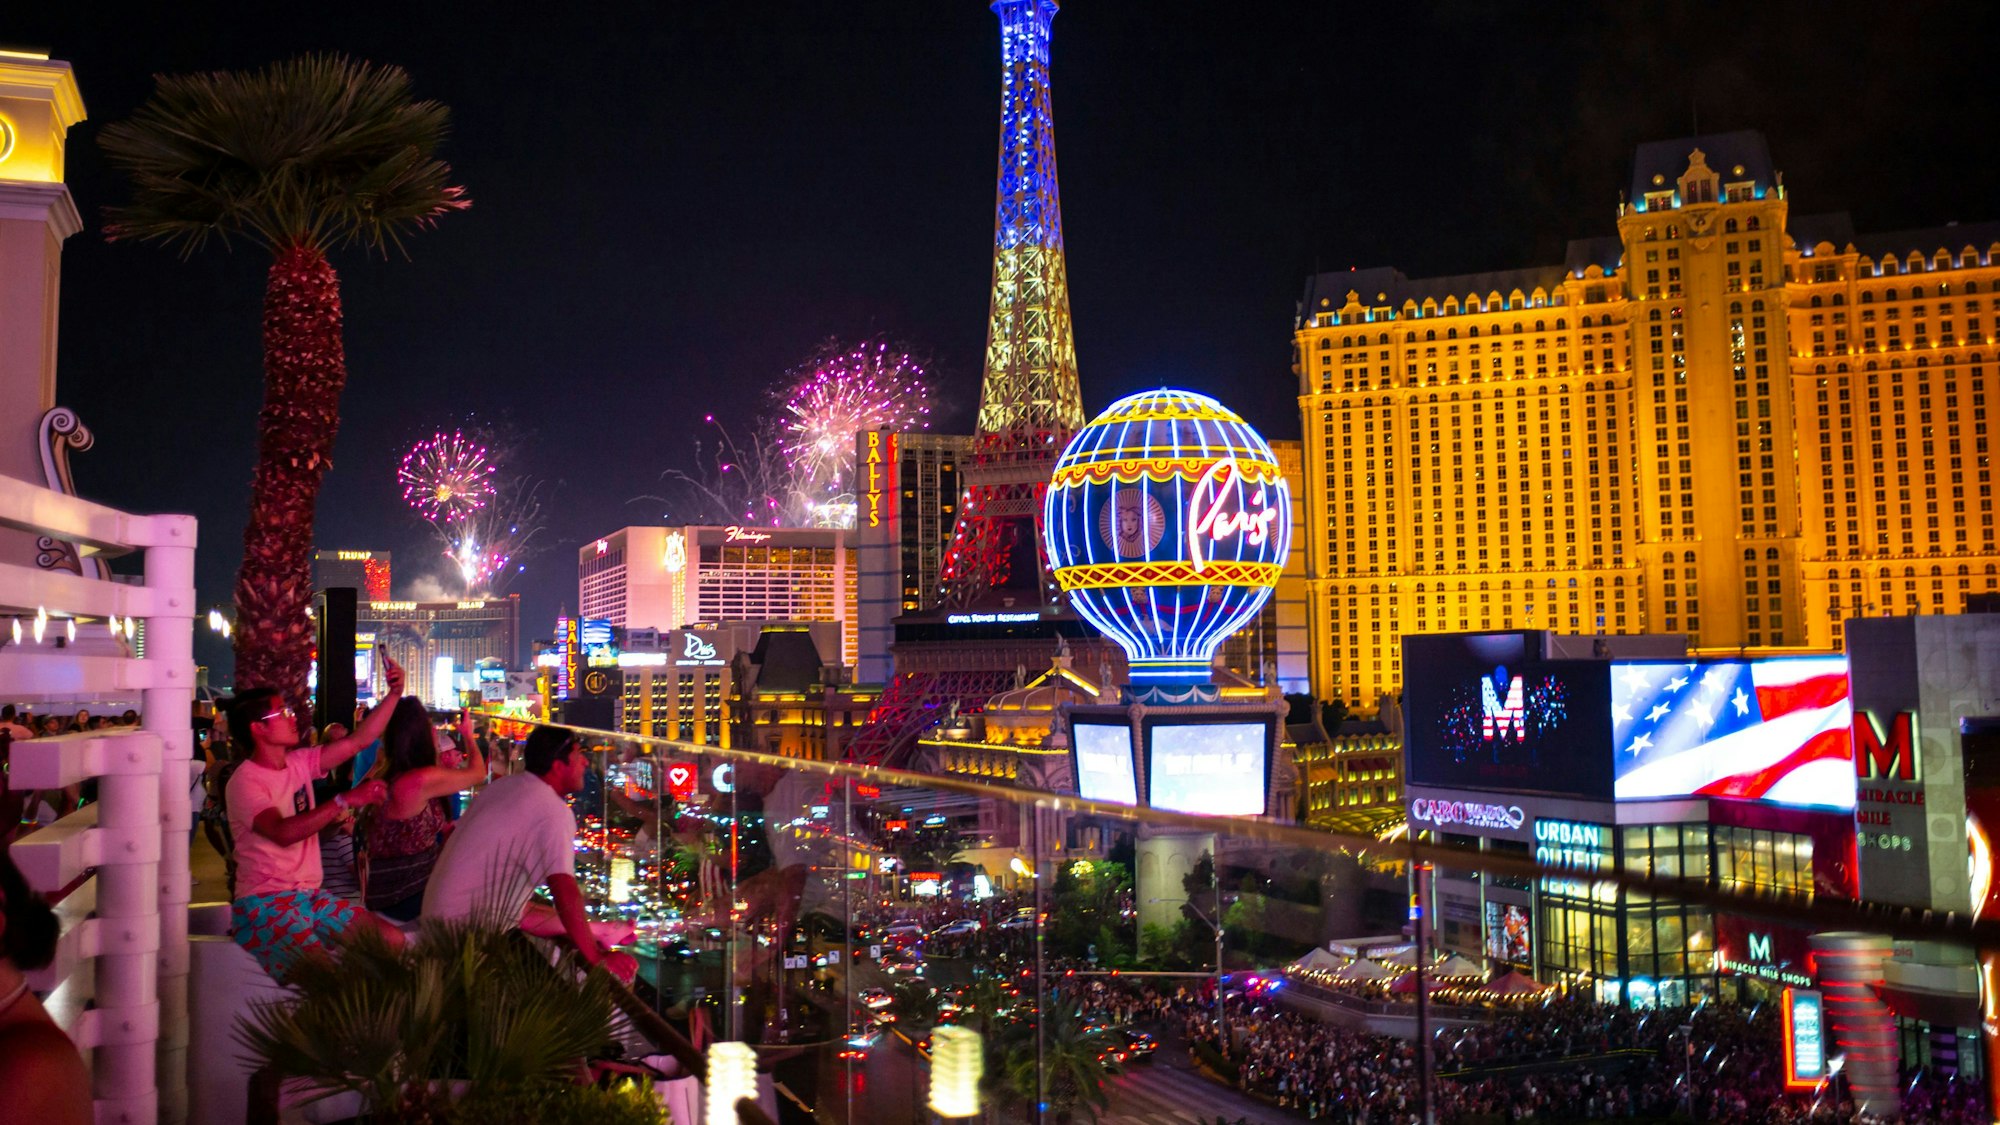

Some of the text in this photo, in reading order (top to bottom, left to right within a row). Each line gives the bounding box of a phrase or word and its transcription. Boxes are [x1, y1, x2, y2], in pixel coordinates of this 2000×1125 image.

[866, 431, 881, 527] BALLYS
[1188, 457, 1277, 573] Paris
[724, 525, 771, 544] Flamingo
[337, 550, 372, 560] TRUMP
[370, 600, 485, 610] TREASURE ISLAND
[997, 612, 1039, 622] RESTAURANT
[566, 620, 577, 689] BALLYS
[1481, 674, 1525, 742] M
[1852, 710, 1921, 781] M
[1856, 788, 1924, 806] MIRACLE
[1857, 810, 1891, 825] MILE
[1535, 820, 1599, 847] URBAN
[1857, 831, 1911, 851] SHOPS
[1748, 932, 1771, 963] M
[1722, 959, 1811, 987] MIRACLE MILE SHOPS
